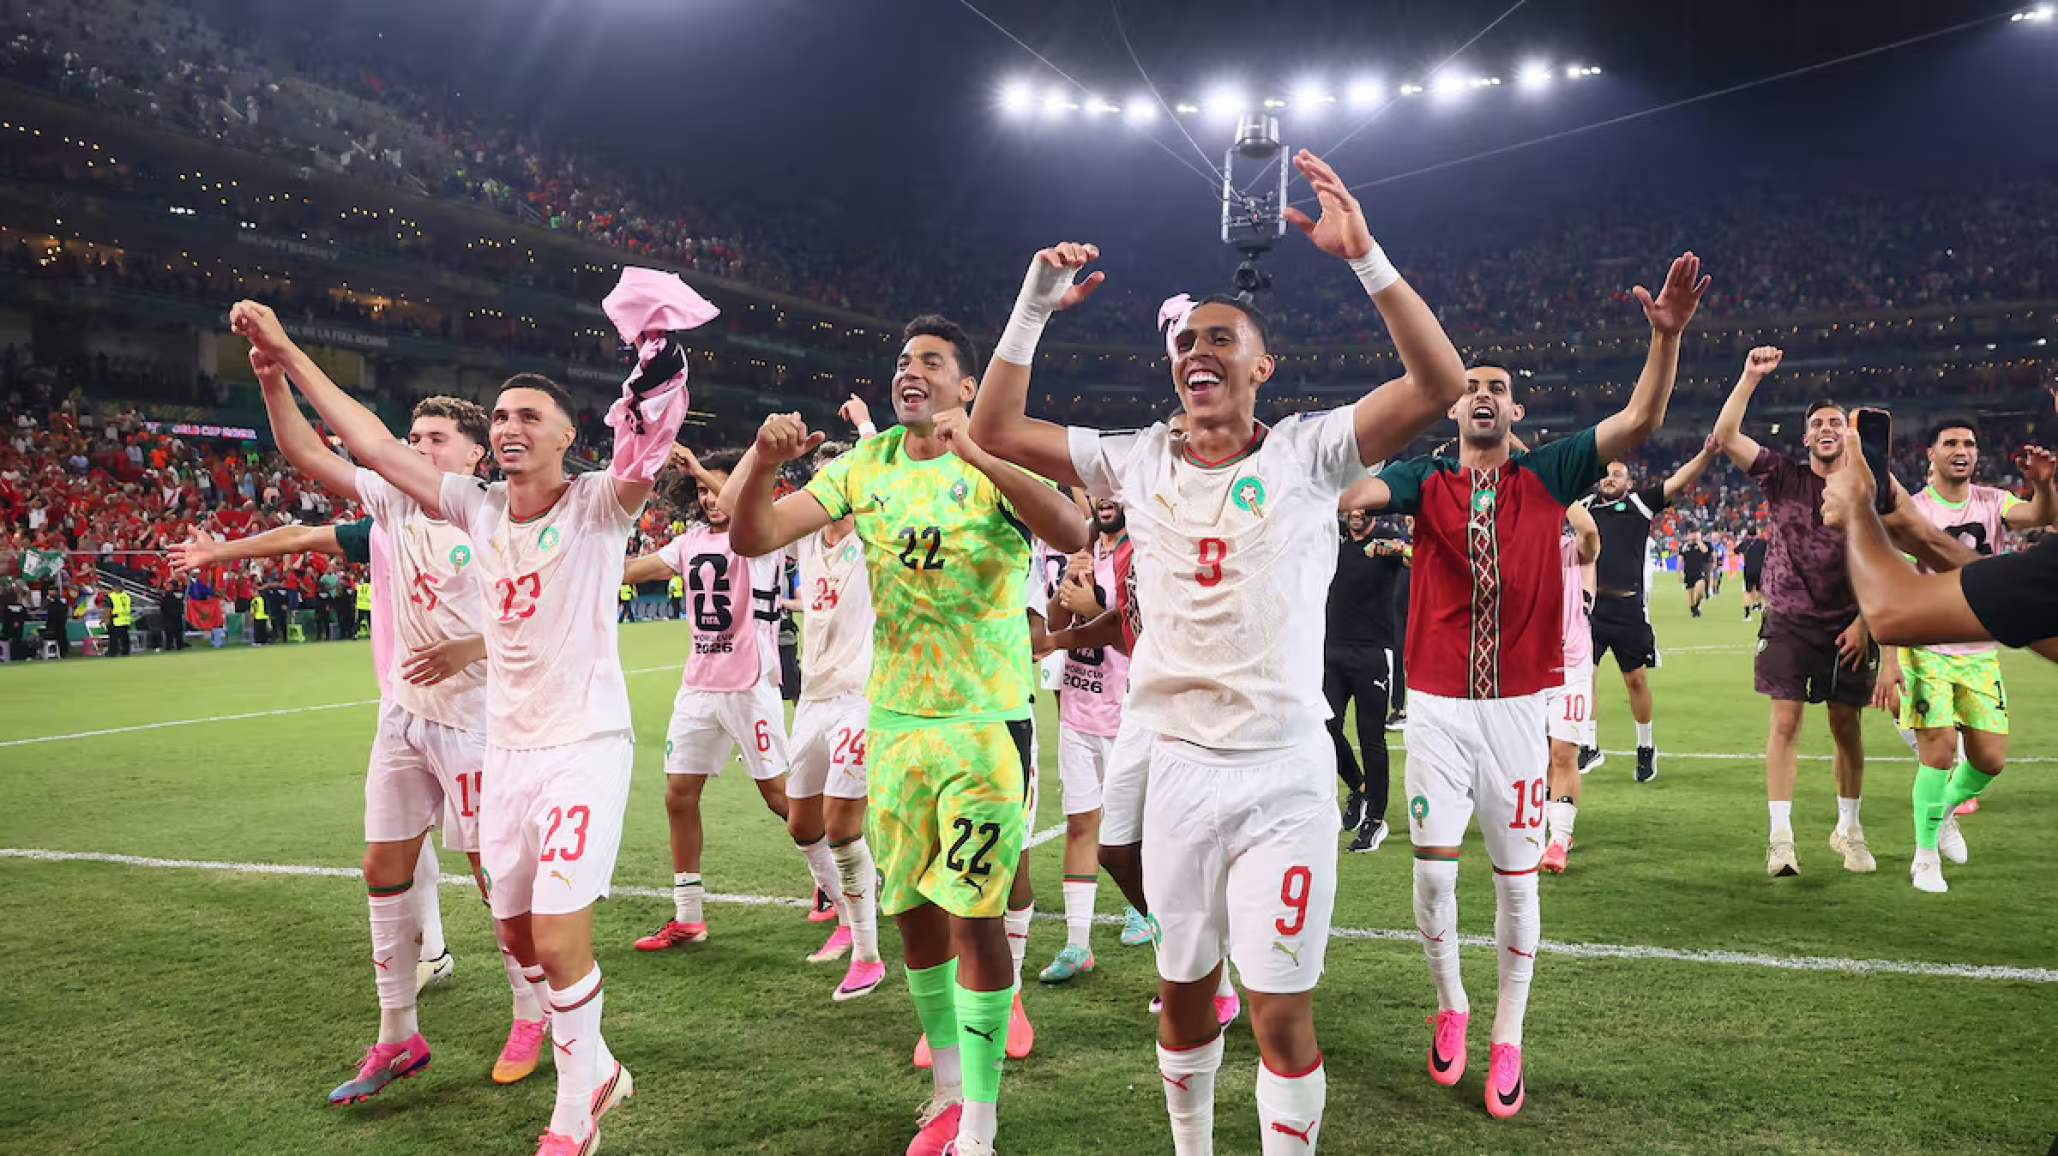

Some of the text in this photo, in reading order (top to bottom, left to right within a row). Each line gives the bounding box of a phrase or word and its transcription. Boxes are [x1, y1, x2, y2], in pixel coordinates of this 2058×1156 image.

[899, 526, 945, 570] 22
[1194, 537, 1227, 587] 9
[495, 572, 541, 621] 23
[812, 577, 838, 611] 24
[694, 642, 733, 654] 2026
[716, 633, 734, 641] CUP
[1062, 673, 1103, 694] 2026
[1562, 694, 1586, 722] 10
[754, 719, 771, 752] 6
[832, 726, 866, 766] 24
[1508, 777, 1545, 829] 19
[540, 805, 591, 862] 23
[946, 817, 1001, 876] 22
[1275, 865, 1312, 936] 9
